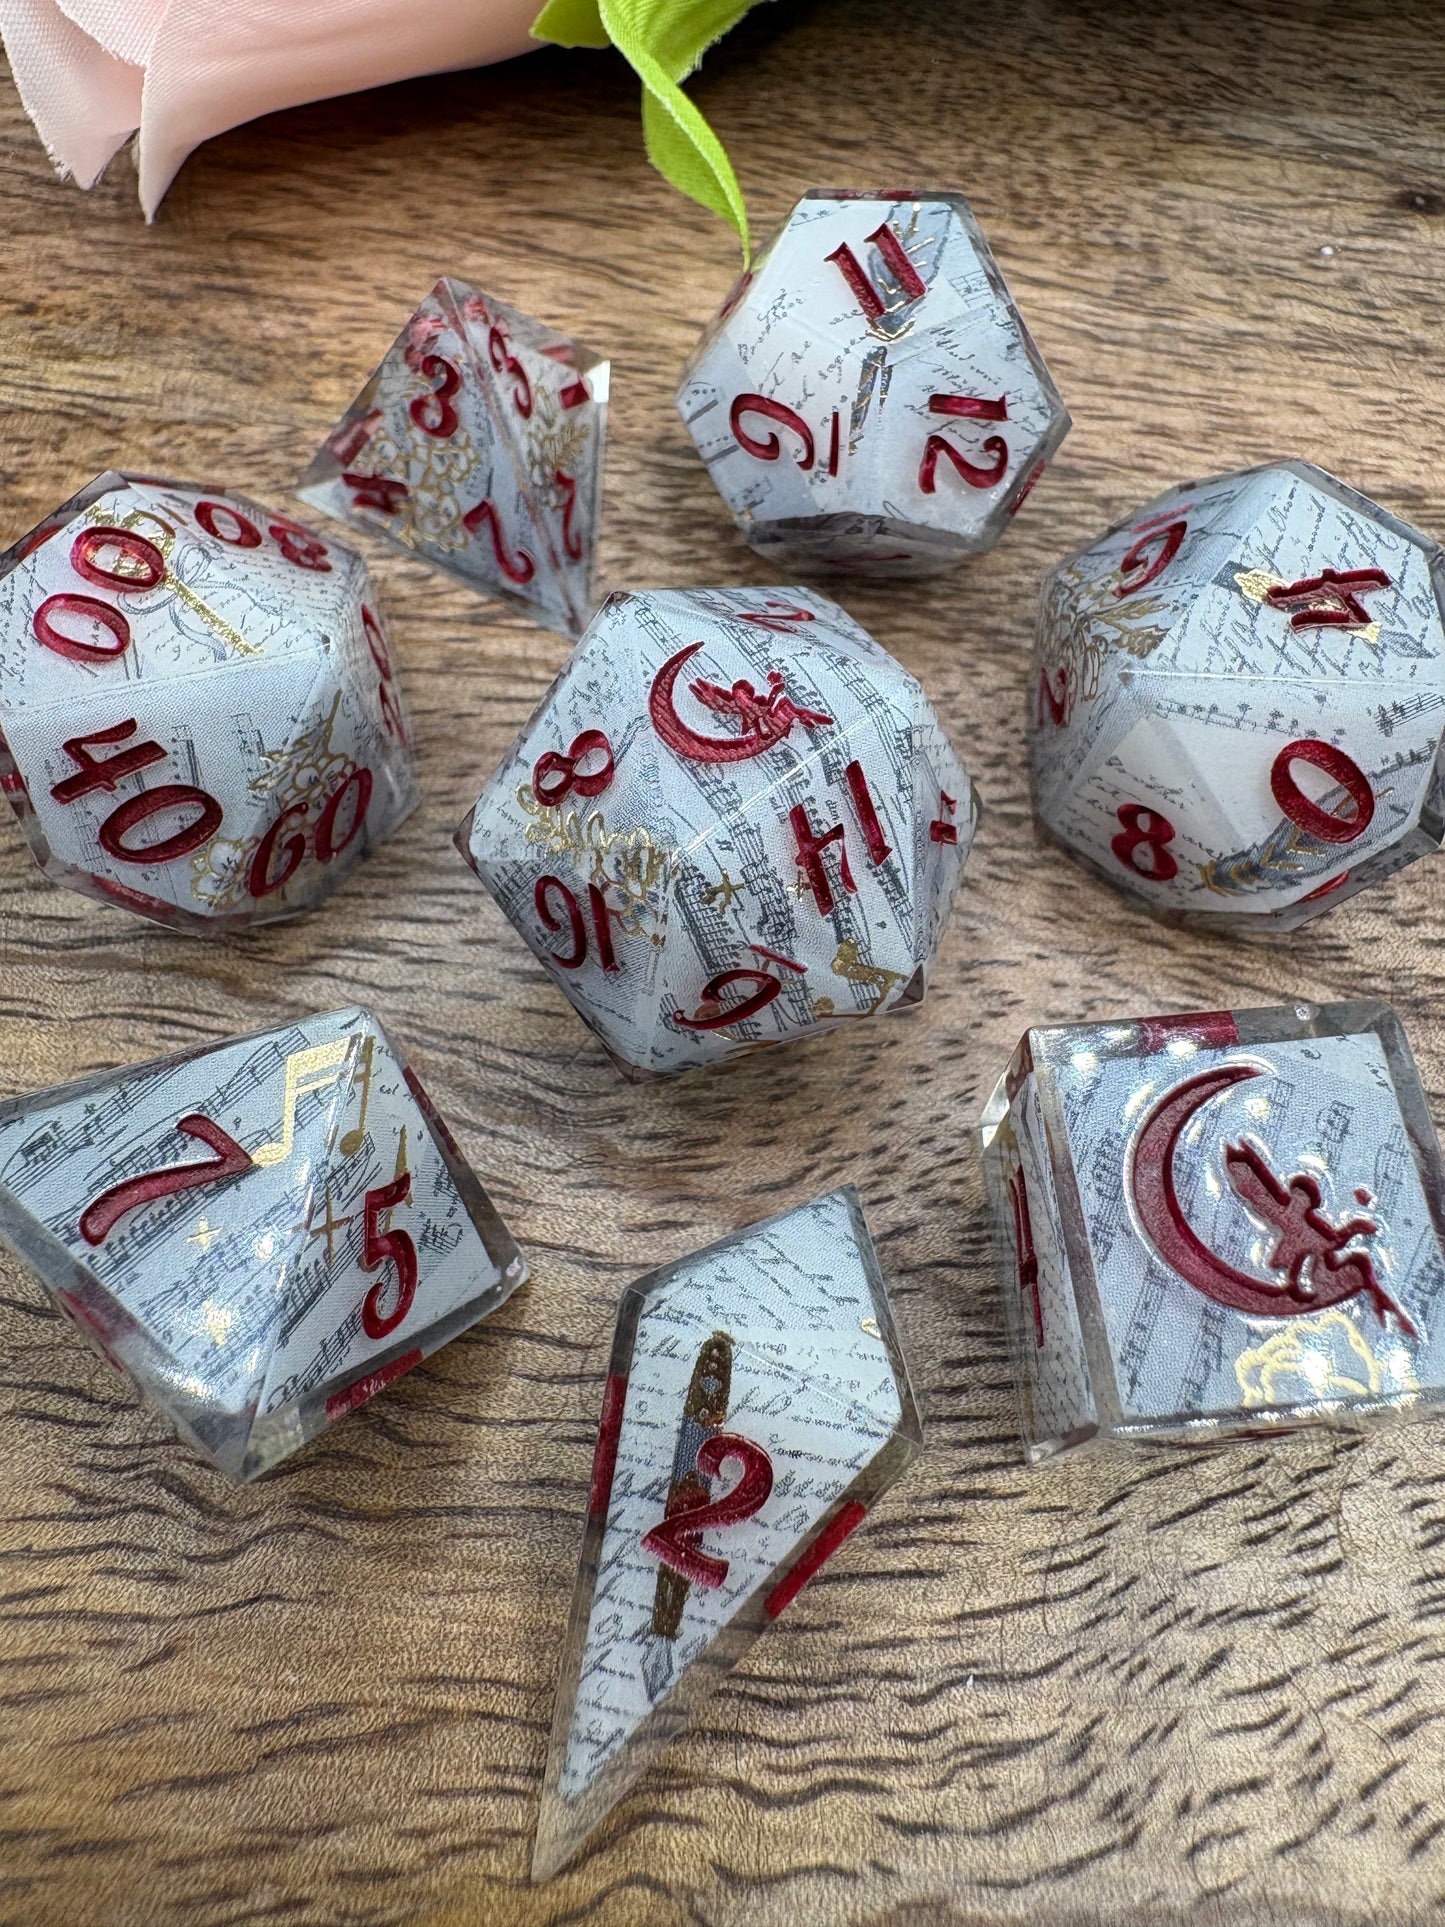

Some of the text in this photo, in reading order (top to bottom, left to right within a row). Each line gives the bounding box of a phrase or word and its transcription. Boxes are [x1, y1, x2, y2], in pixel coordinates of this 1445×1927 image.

[824, 223, 927, 321] 11
[410, 354, 462, 438] 3
[918, 394, 1009, 494] 12
[32, 525, 166, 663] 00
[1266, 567, 1394, 632] 4
[50, 717, 223, 865] 40
[533, 729, 615, 807] 8
[1271, 739, 1376, 844] 0
[249, 768, 373, 898] 60
[789, 760, 893, 917] 14
[1111, 803, 1179, 882] 8
[534, 875, 619, 973] 16
[79, 1113, 253, 1247] 7
[361, 1172, 418, 1341] 5
[641, 1432, 774, 1590] 2
